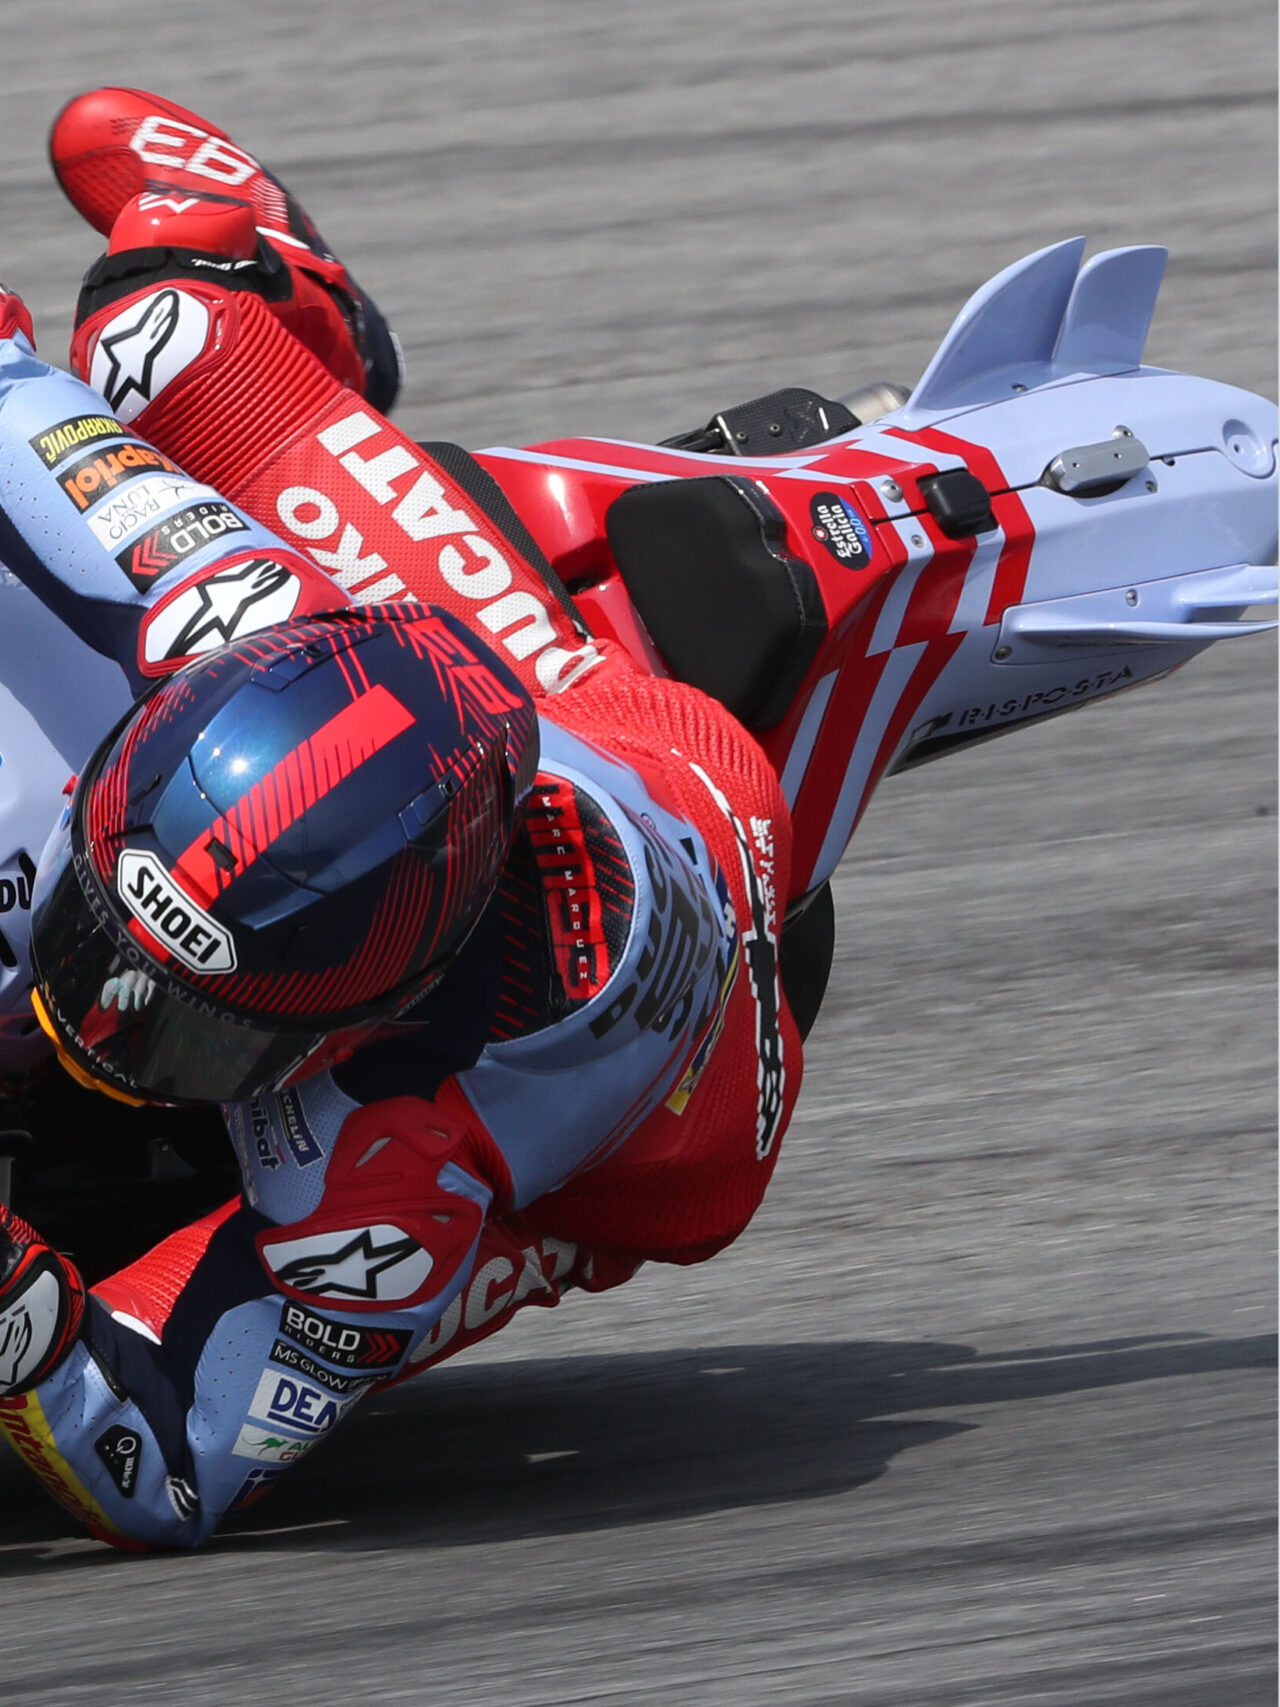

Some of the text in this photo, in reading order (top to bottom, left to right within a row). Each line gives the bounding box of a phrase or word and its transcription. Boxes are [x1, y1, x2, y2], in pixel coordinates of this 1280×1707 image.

[170, 513, 243, 554] BOLD
[816, 504, 853, 558] Estrella
[831, 504, 863, 554] Galicia
[316, 411, 607, 697] DUCATI
[127, 866, 222, 964] SHOEI
[118, 930, 157, 979] YOU
[286, 1306, 361, 1351] BOLD
[274, 1344, 299, 1364] MS
[299, 1357, 348, 1390] GLOW
